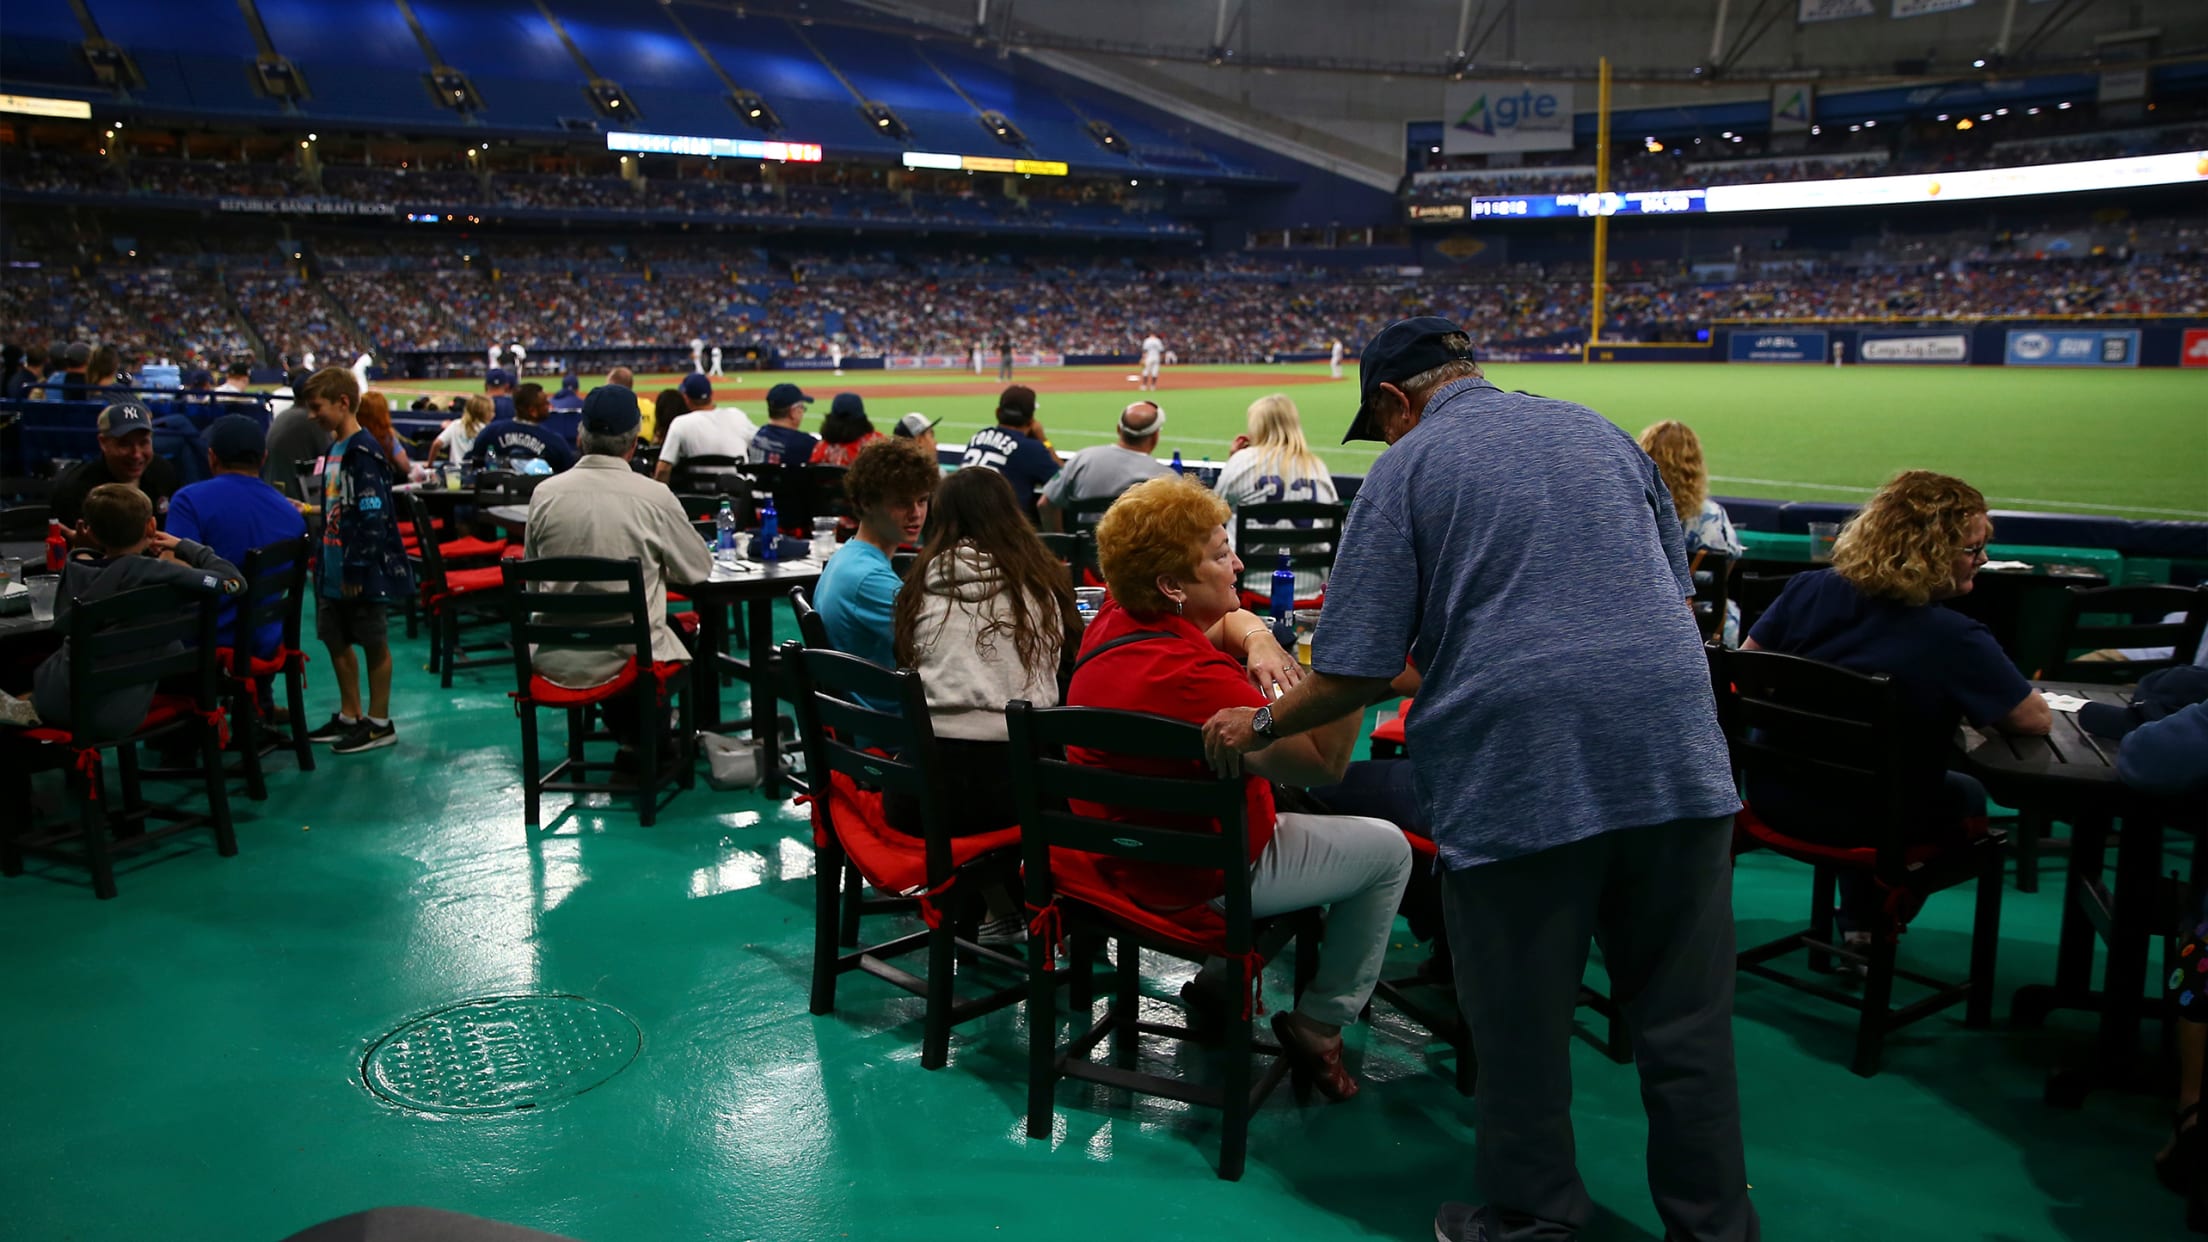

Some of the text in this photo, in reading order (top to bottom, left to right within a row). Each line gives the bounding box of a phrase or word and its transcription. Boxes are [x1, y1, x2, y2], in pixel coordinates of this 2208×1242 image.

[1496, 88, 1558, 128] gte
[123, 405, 139, 419] NY
[498, 431, 546, 455] LONGORIA
[970, 429, 1019, 456] TORRES
